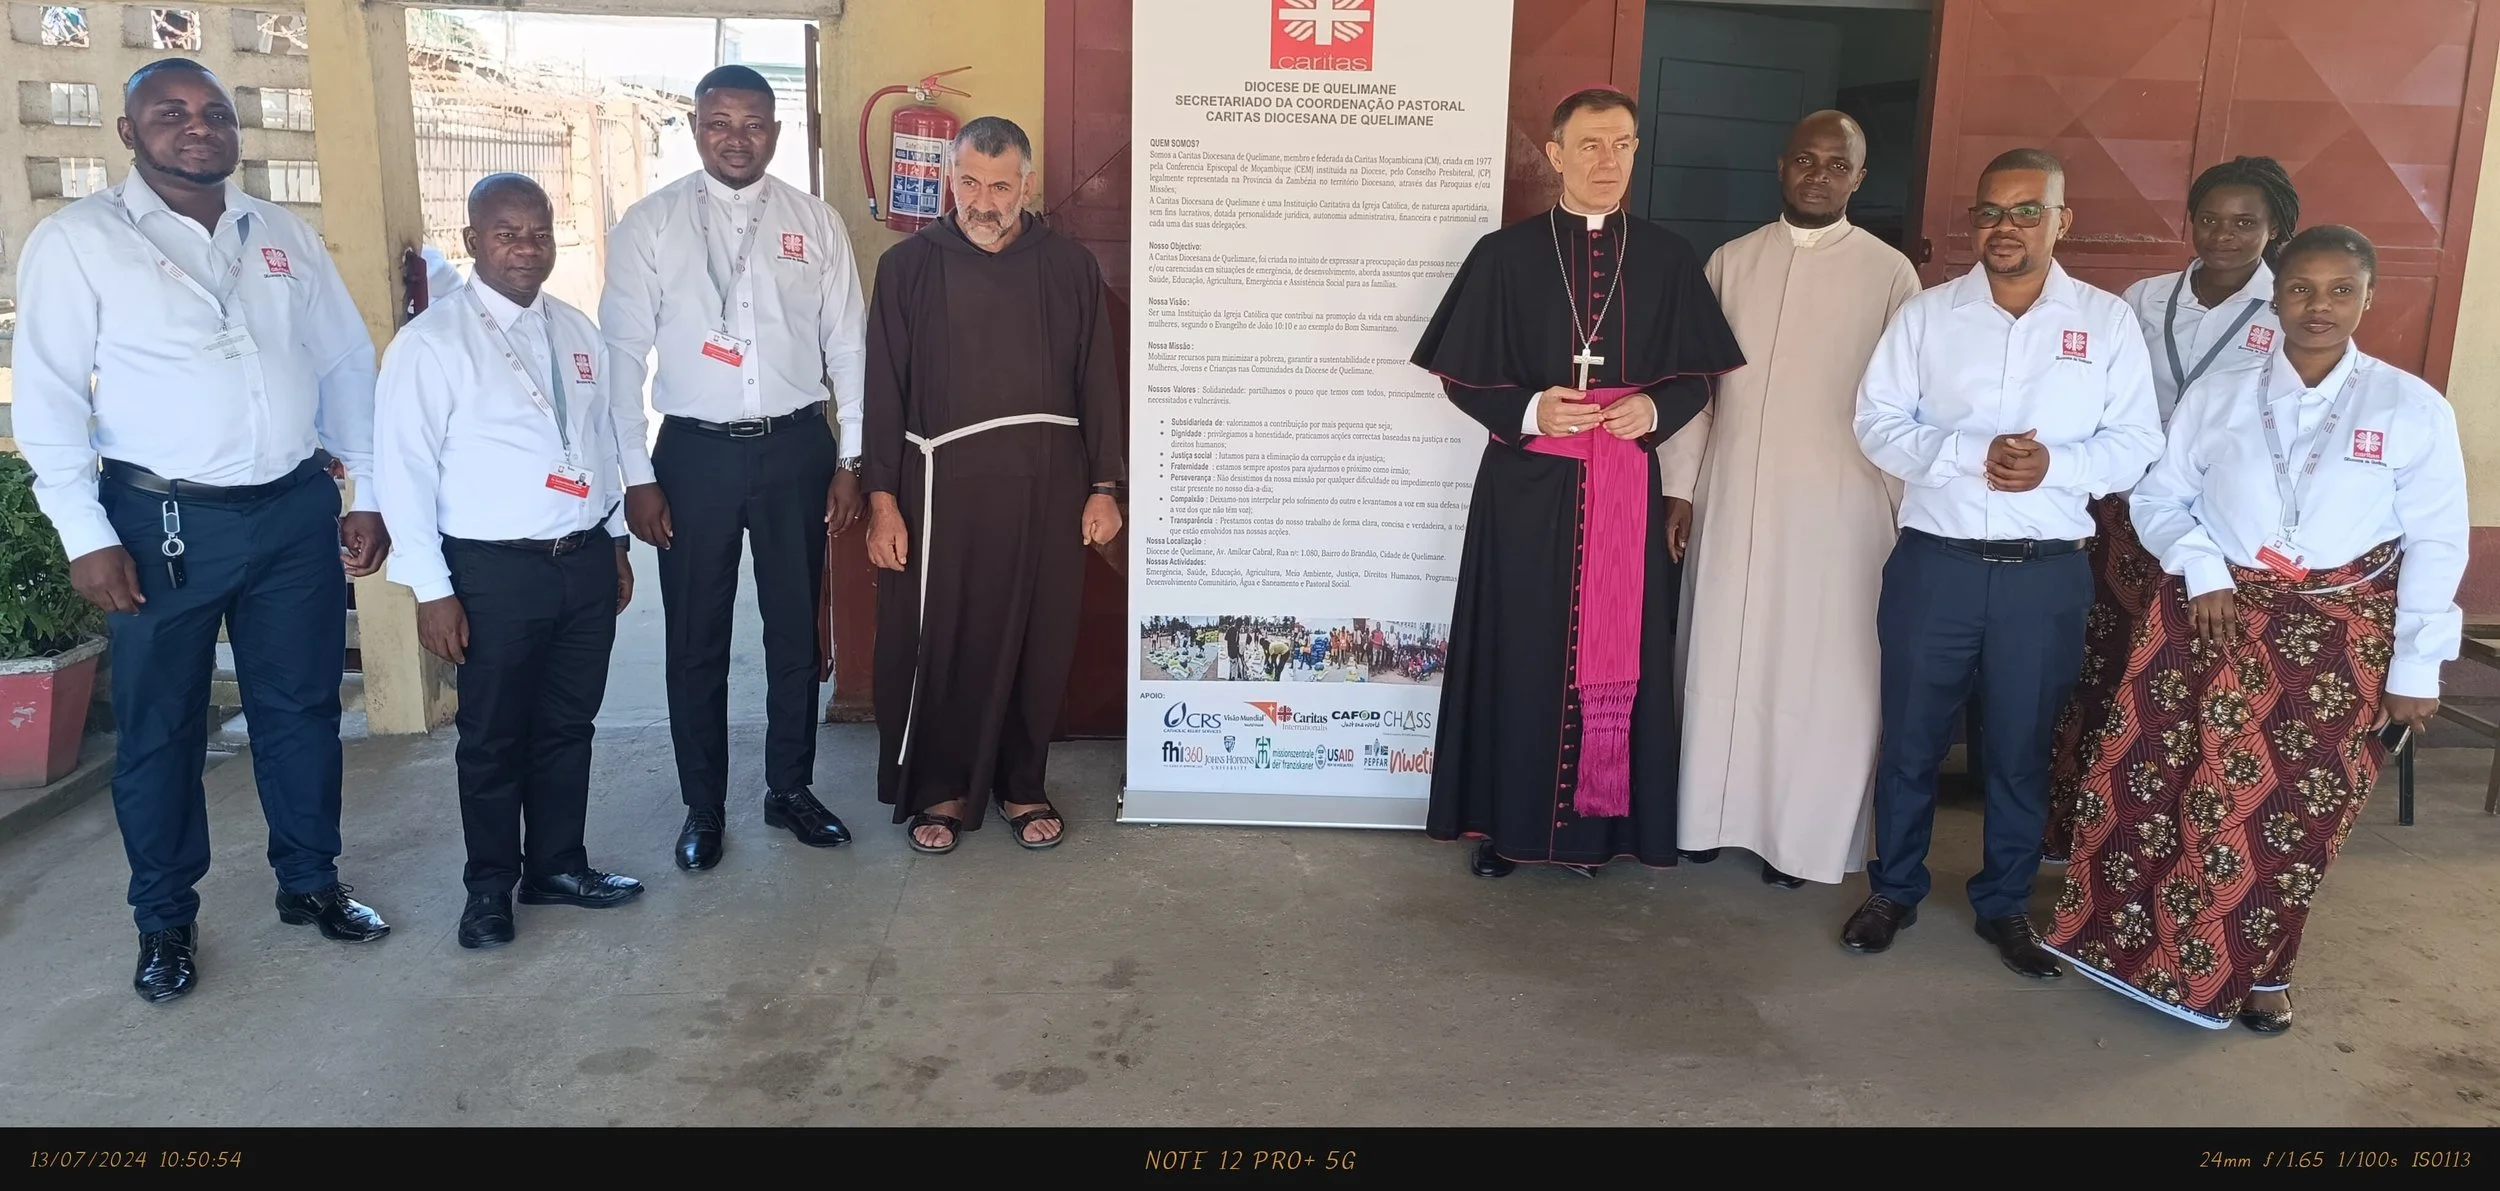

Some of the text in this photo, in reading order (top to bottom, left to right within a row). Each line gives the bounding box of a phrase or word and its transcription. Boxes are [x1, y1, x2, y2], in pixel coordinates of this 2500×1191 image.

[1279, 52, 1367, 70] caritas
[1245, 81, 1396, 96] DIOCESE DE QUELIMANE
[1175, 95, 1465, 111] SECRETARIADO DA COORDENAÇÃO PASTORAL
[1206, 111, 1433, 127] CARITAS DIOCESANA DE QUELIMANE
[1150, 138, 1199, 148] QUEM SOMOS?
[1149, 241, 1201, 253] Nosso Objectivo:
[1149, 297, 1168, 305] Nossa
[1148, 341, 1167, 350] Nossa
[1148, 385, 1196, 393] Nossos Valores
[1146, 536, 1165, 545] Nossa
[1166, 536, 1201, 547] Localização
[1146, 557, 1206, 566] Nossas Actividades:
[1186, 713, 1221, 728] CRS
[1293, 712, 1328, 723] Caritas
[1332, 710, 1380, 720] CAFOD
[1384, 710, 1431, 731] CHASS
[1272, 748, 1314, 758] missionszentrale
[1327, 748, 1354, 762] USAID
[1204, 755, 1254, 765] JOHNS HOPKINS
[1282, 759, 1314, 770] franziskaner
[1364, 758, 1388, 766] PEPFAR
